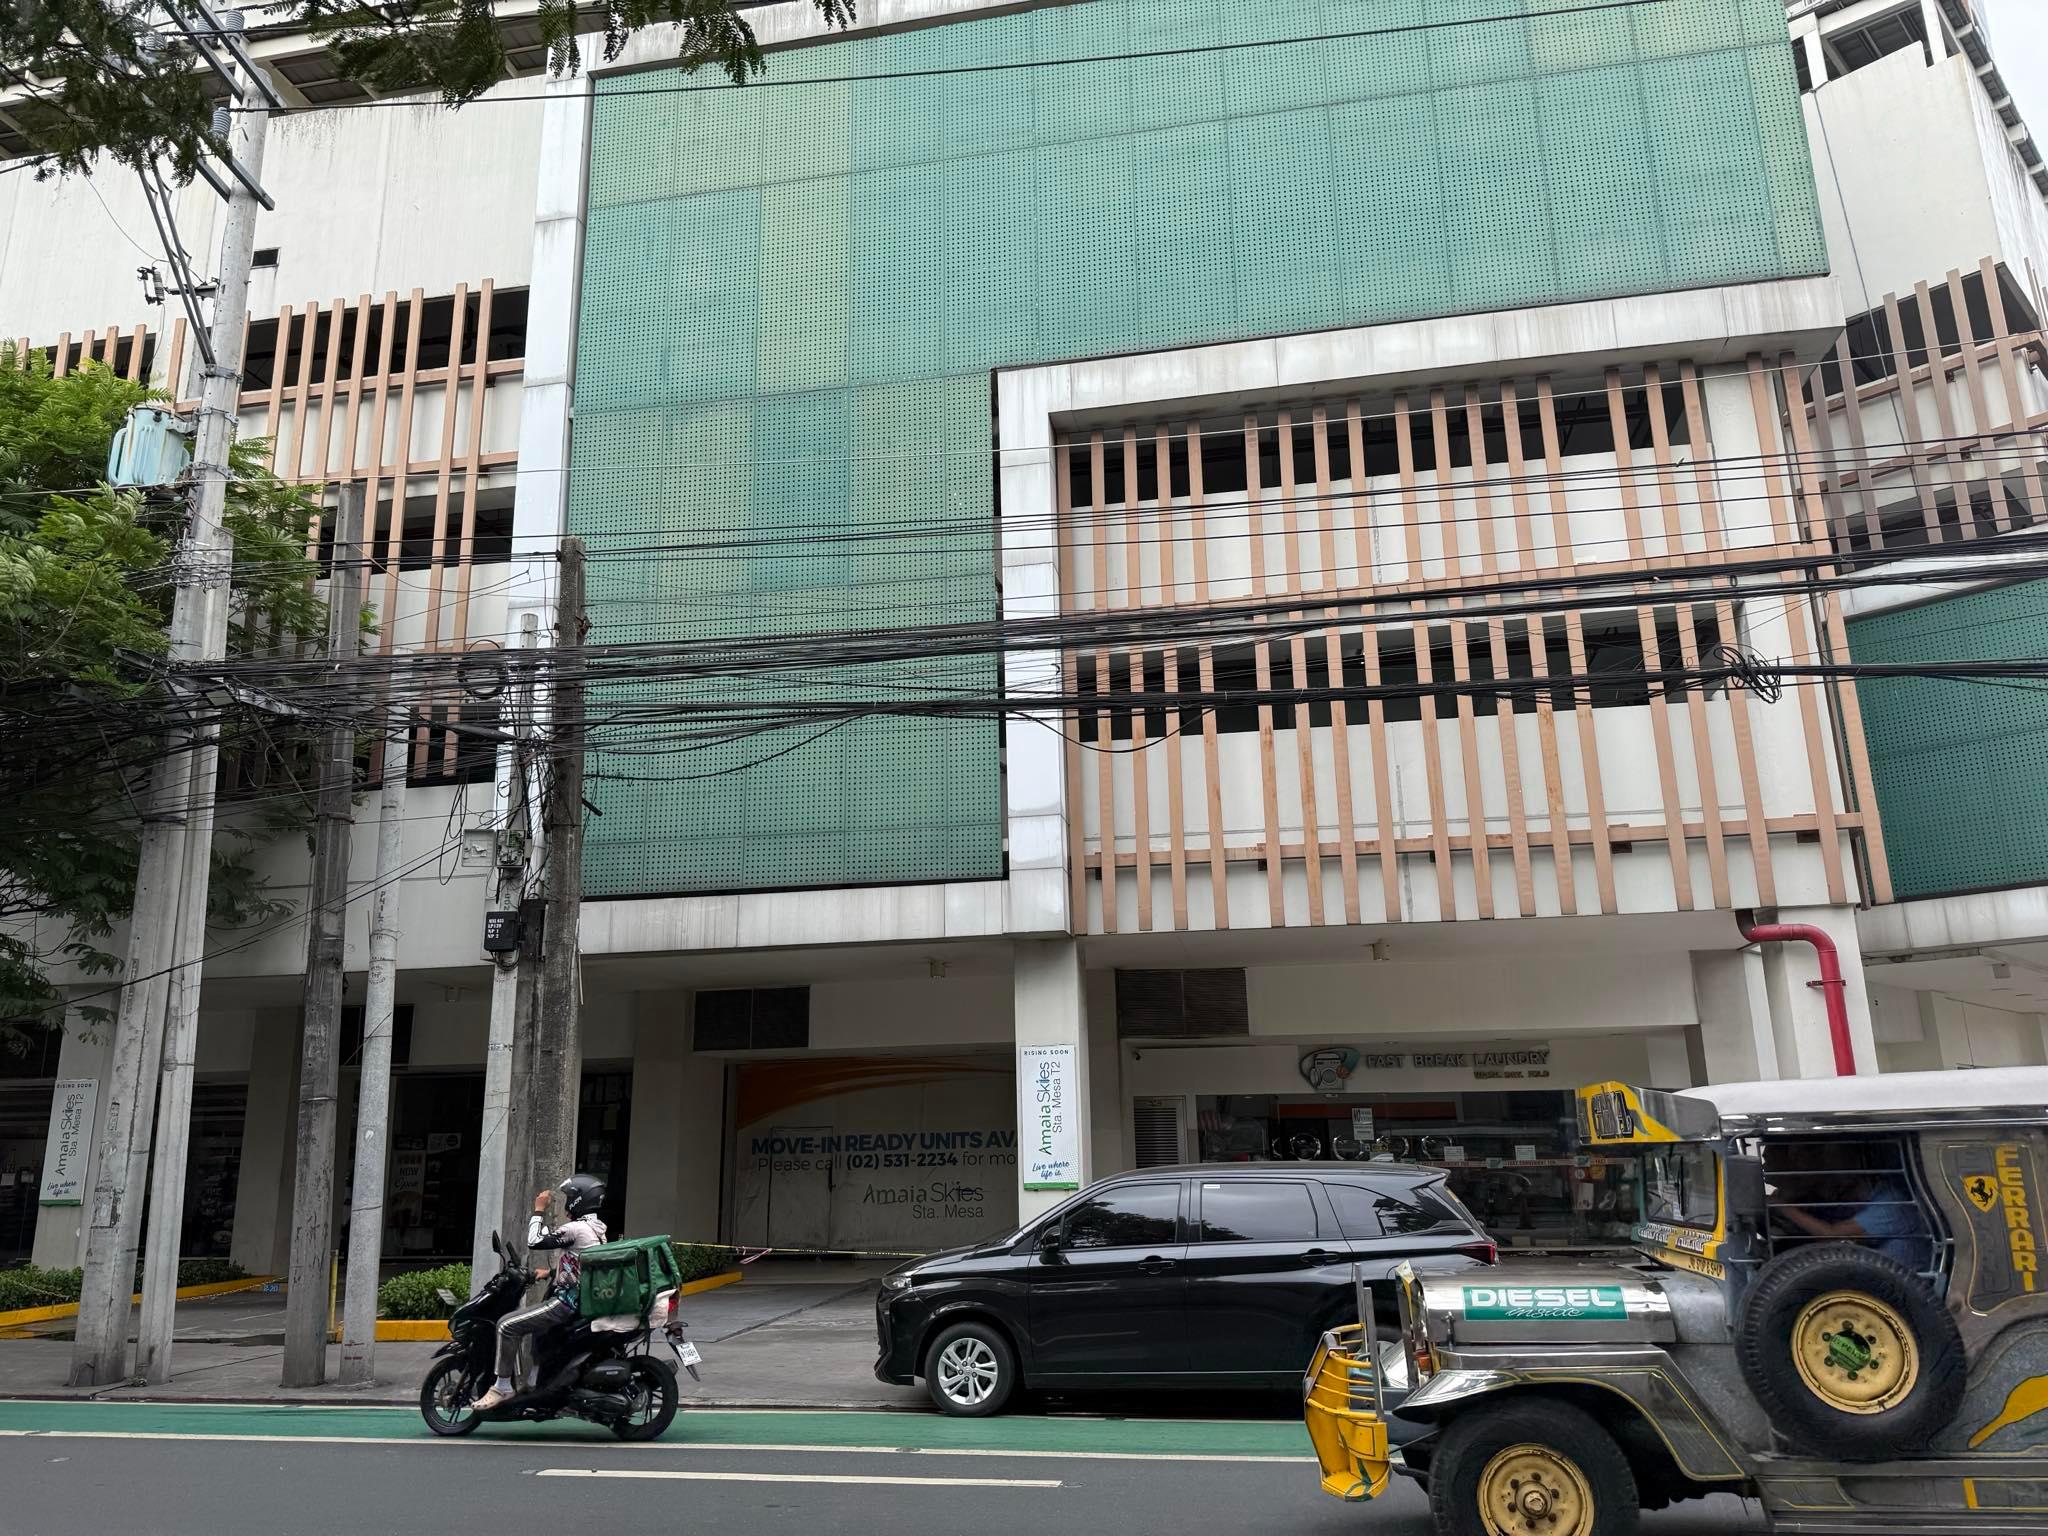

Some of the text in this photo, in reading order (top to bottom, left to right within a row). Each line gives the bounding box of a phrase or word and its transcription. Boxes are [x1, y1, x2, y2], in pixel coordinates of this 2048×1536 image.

[1367, 1051, 1550, 1069] FAST BREAK LAUNDRY
[75, 1093, 85, 1107] T2
[1036, 1061, 1052, 1155] Amaia Skies
[1051, 1061, 1062, 1133] Sta. Mesa T2
[72, 1108, 82, 1135] Mesa
[55, 1094, 76, 1176] Amaia Skies
[752, 1131, 1018, 1155] MOVE-IN READY UNITS AV
[758, 1158, 810, 1172] Please
[815, 1156, 842, 1171] call
[846, 1154, 879, 1170] (02)
[883, 1152, 959, 1168] 531-2234
[962, 1151, 985, 1166] for
[863, 1181, 984, 1205] Amaia Skies
[912, 1204, 984, 1219] Sta. Mesa
[1995, 1143, 2039, 1292] FERRARI
[1471, 1288, 1616, 1307] DIESEL
[1505, 1307, 1585, 1318] inside
